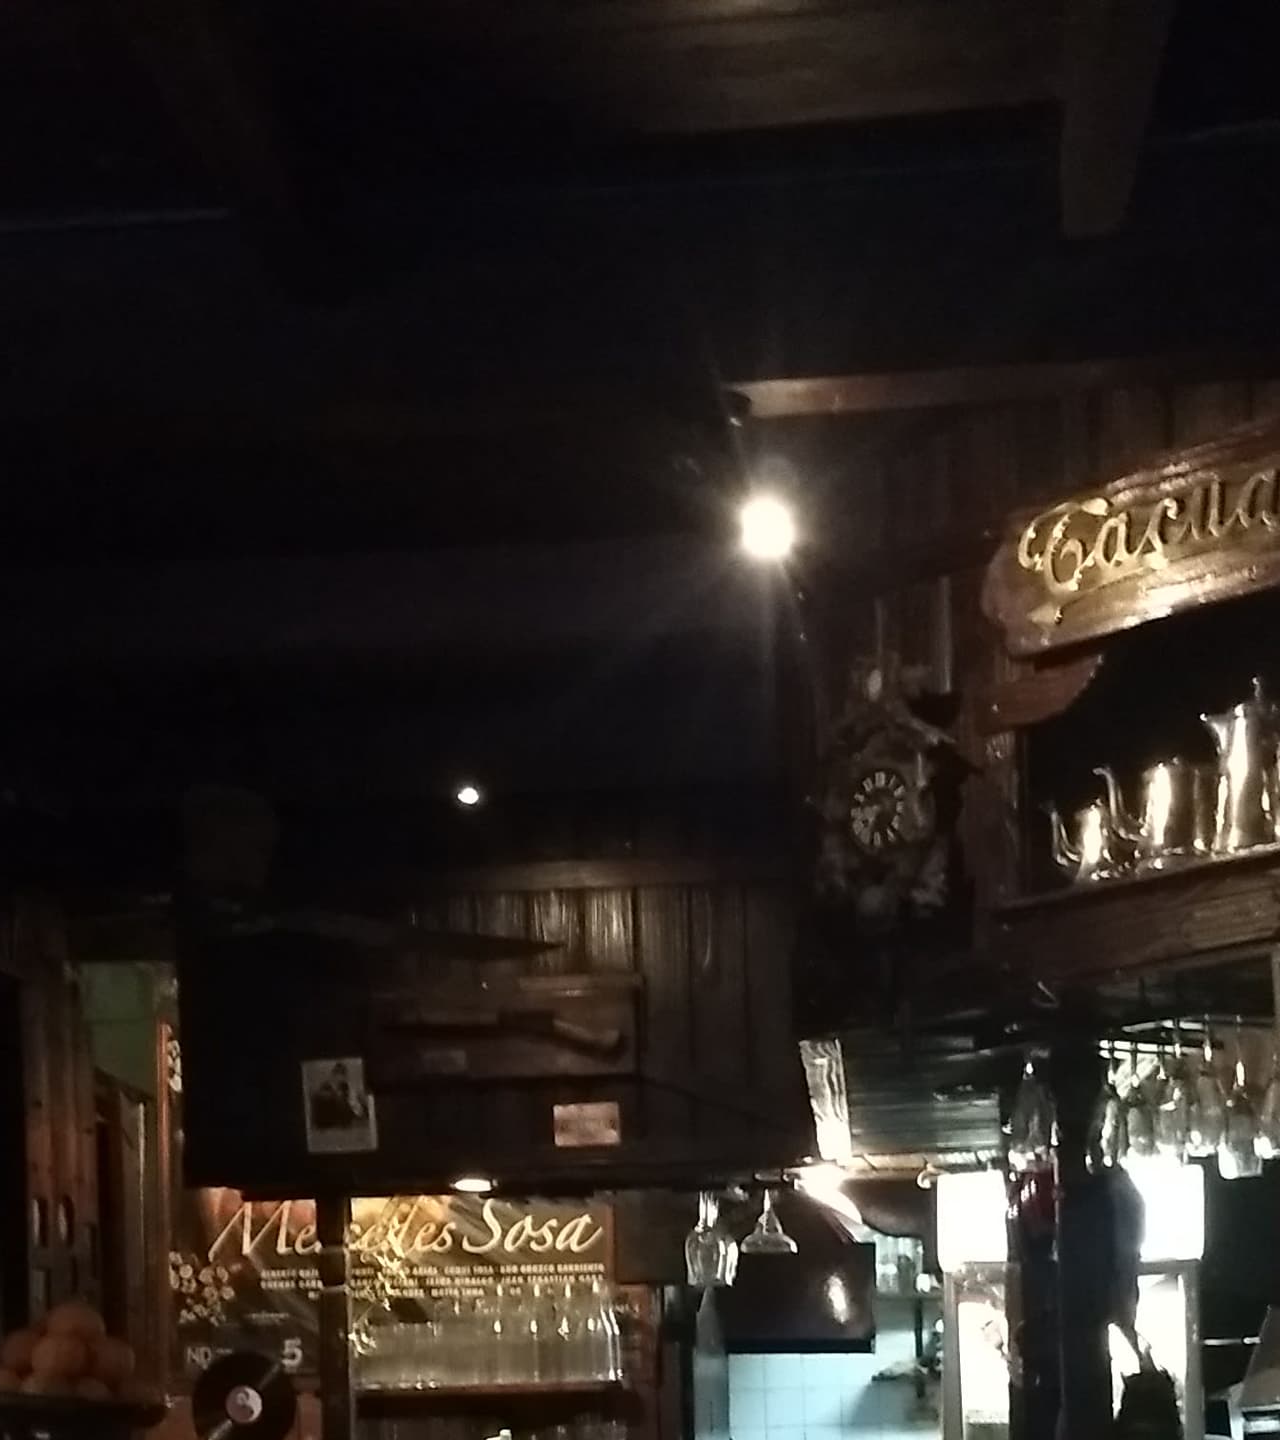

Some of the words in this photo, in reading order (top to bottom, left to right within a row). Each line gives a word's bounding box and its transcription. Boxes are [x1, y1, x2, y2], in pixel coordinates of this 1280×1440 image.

[208, 1196, 457, 1263] Mecedes
[463, 1199, 603, 1256] Sosa
[281, 1337, 304, 1369] 5
